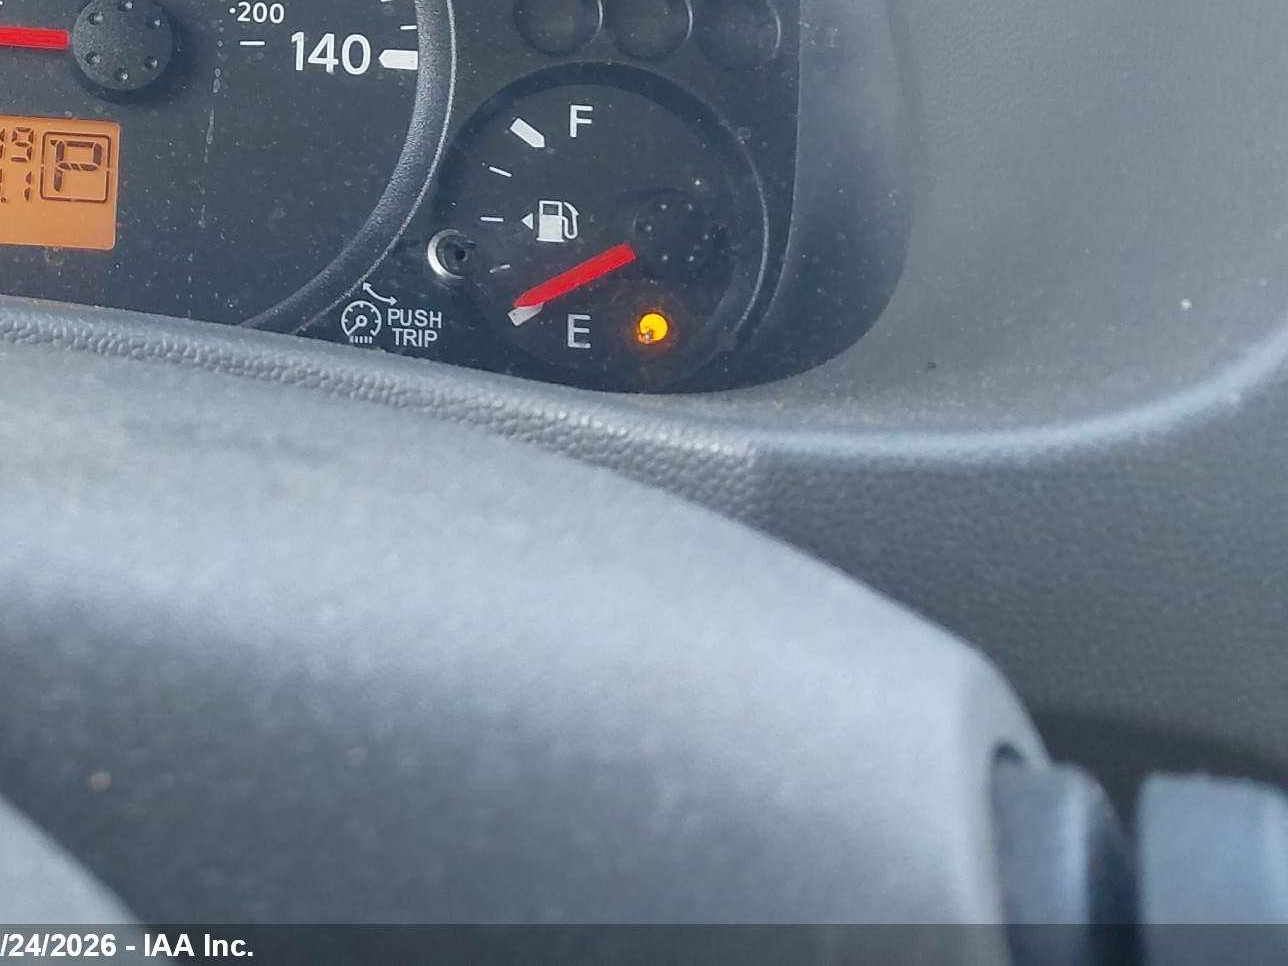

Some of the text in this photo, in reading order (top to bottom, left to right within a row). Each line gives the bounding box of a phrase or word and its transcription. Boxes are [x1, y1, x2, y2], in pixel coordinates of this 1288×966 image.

[237, 2, 285, 25] 200
[291, 32, 372, 75] 140
[569, 104, 593, 138] F
[50, 139, 103, 192] P
[388, 308, 443, 330] PUSH
[567, 314, 591, 349] E
[392, 328, 439, 348] TRIP
